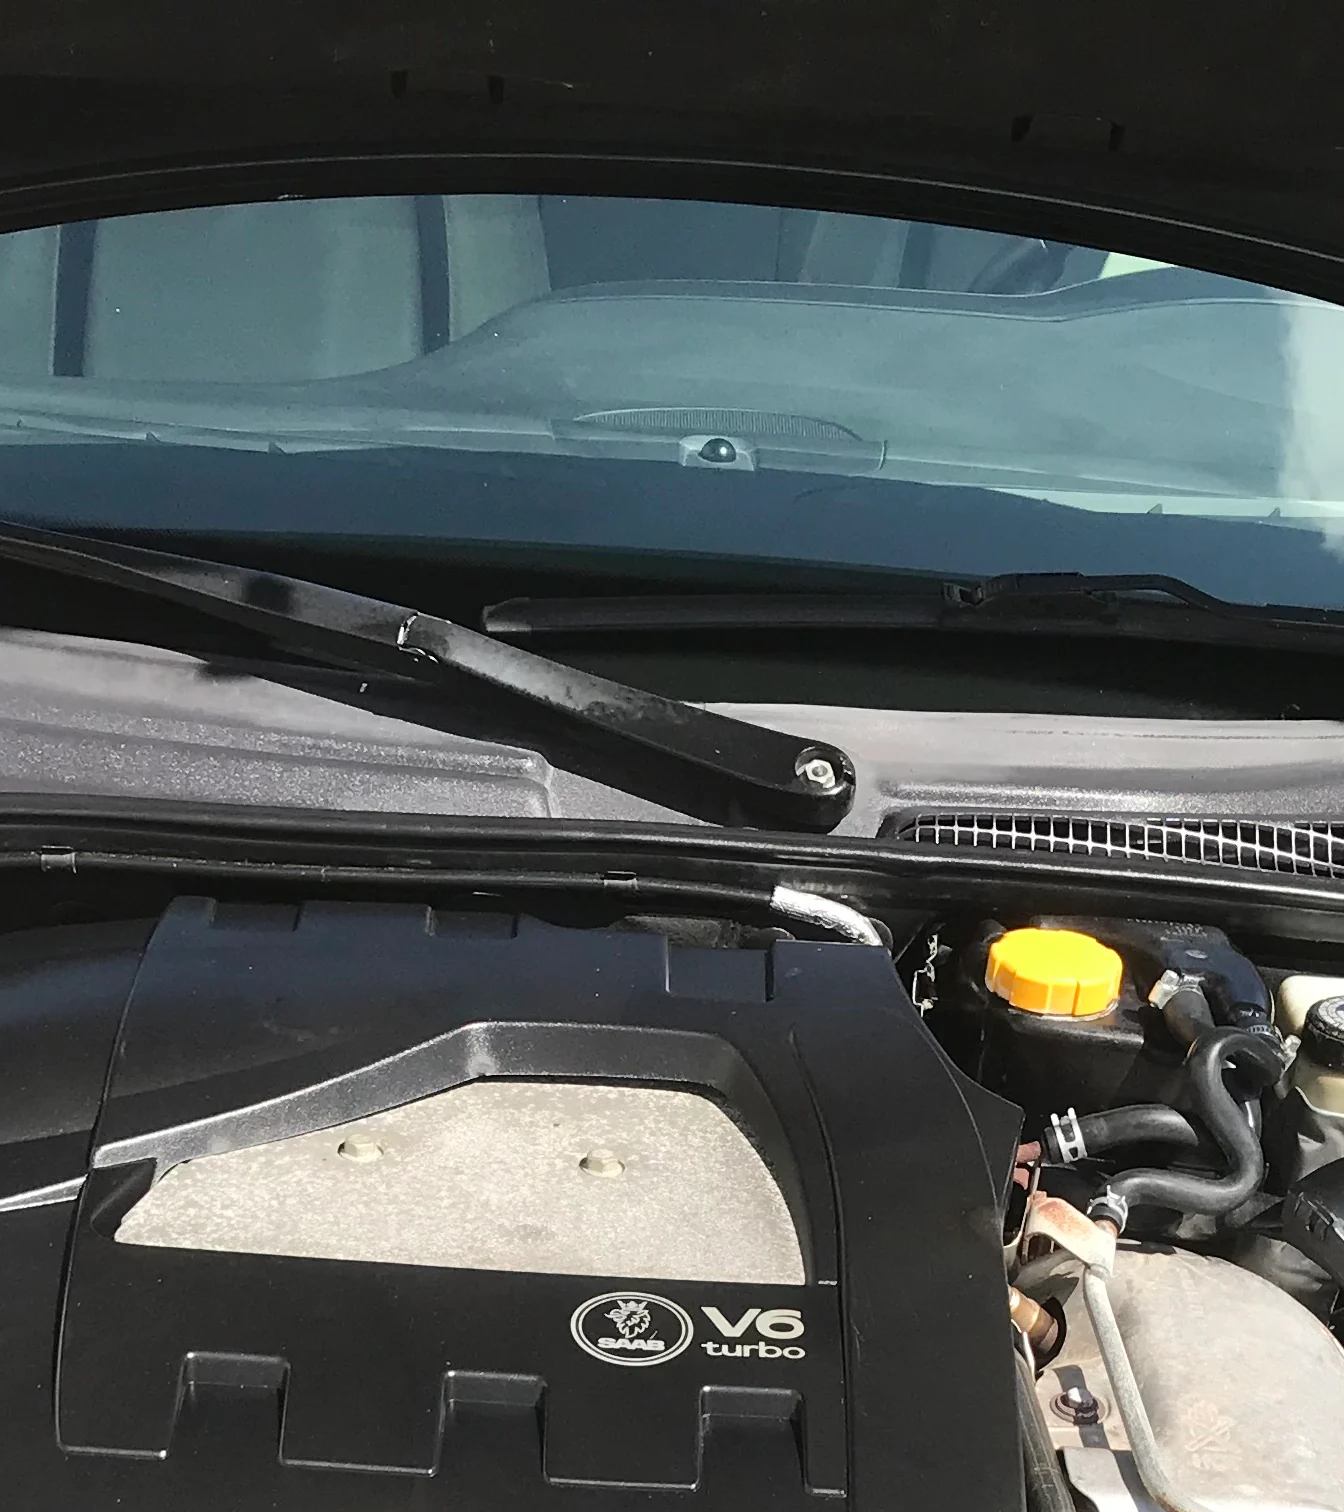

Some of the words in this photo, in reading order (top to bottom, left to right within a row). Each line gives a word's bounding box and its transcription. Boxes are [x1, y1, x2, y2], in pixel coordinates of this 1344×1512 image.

[701, 1306, 806, 1340] V6
[597, 1337, 666, 1350] SAAB
[701, 1342, 806, 1359] turbo
